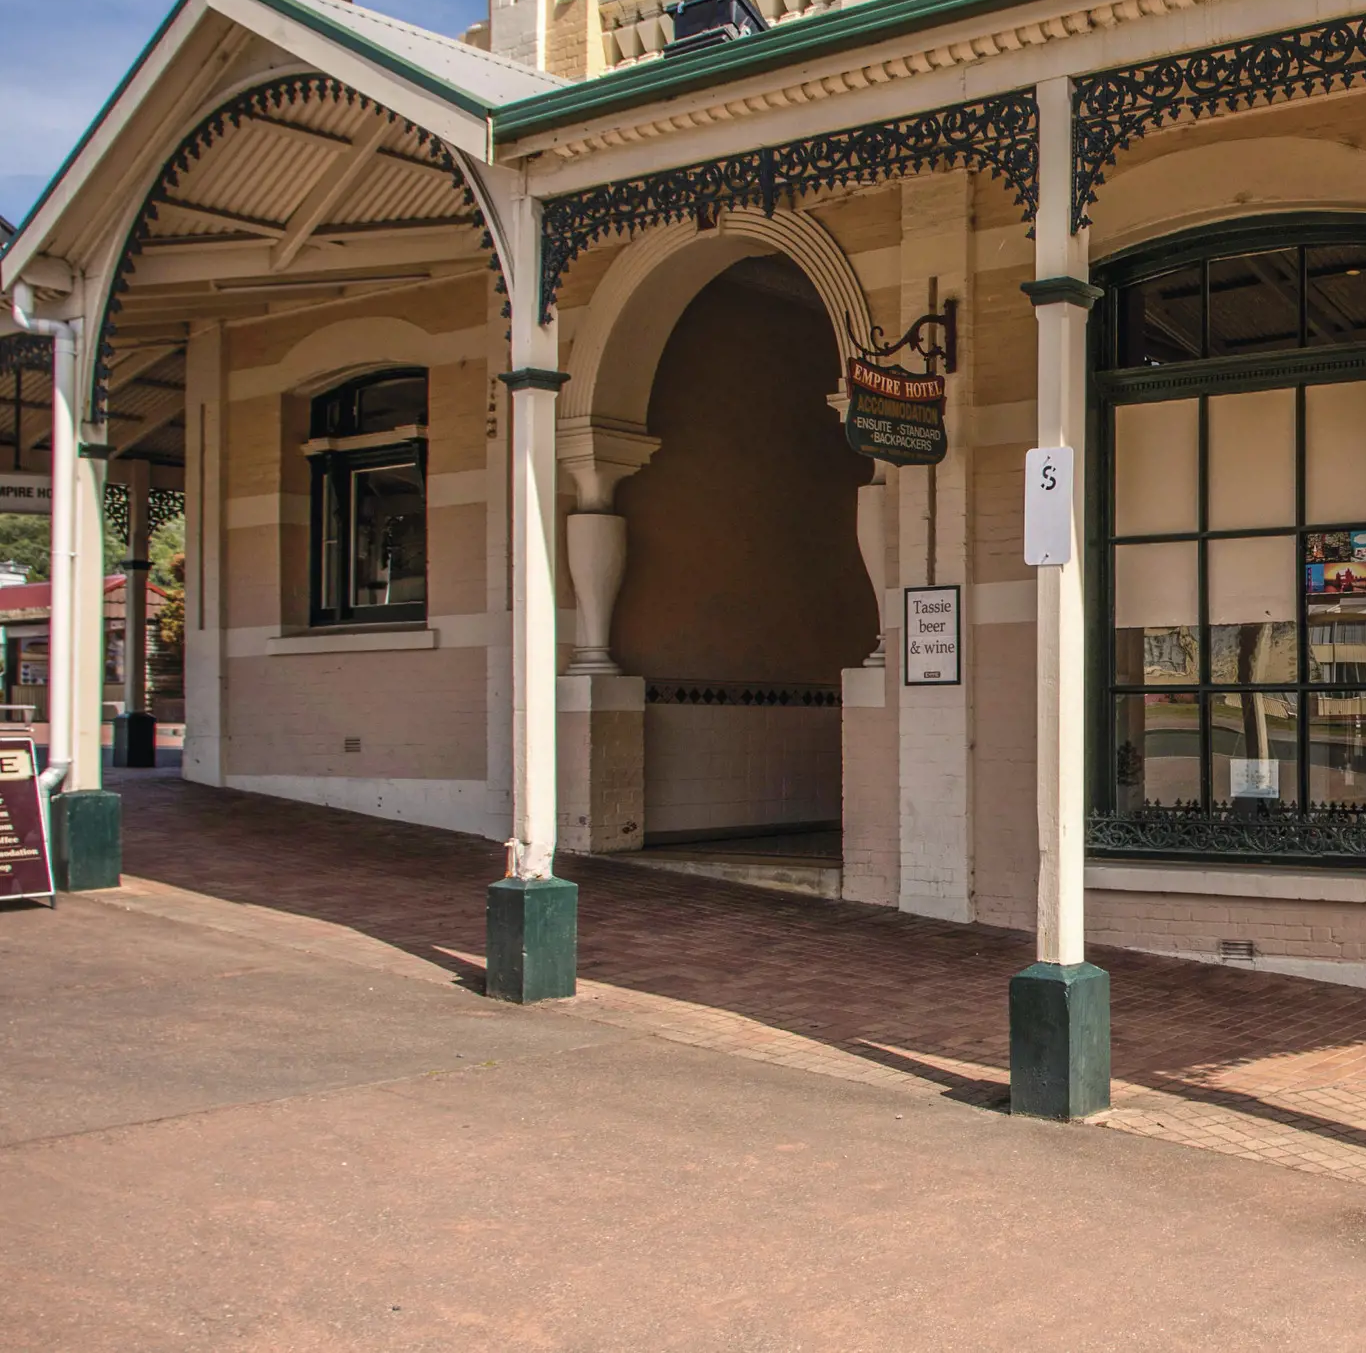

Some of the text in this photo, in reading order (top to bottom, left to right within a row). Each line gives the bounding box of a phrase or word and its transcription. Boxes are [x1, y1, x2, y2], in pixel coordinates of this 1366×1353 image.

[853, 363, 943, 398] EMPIRE HOTEL
[857, 393, 939, 425] ACCOMMODATION
[856, 416, 941, 441] ENSUITE STANDARD
[873, 431, 932, 452] BACKPACKERS
[1041, 465, 1057, 491] S
[913, 599, 952, 614] Tassie
[919, 619, 946, 633] beer
[910, 639, 955, 654] & wine
